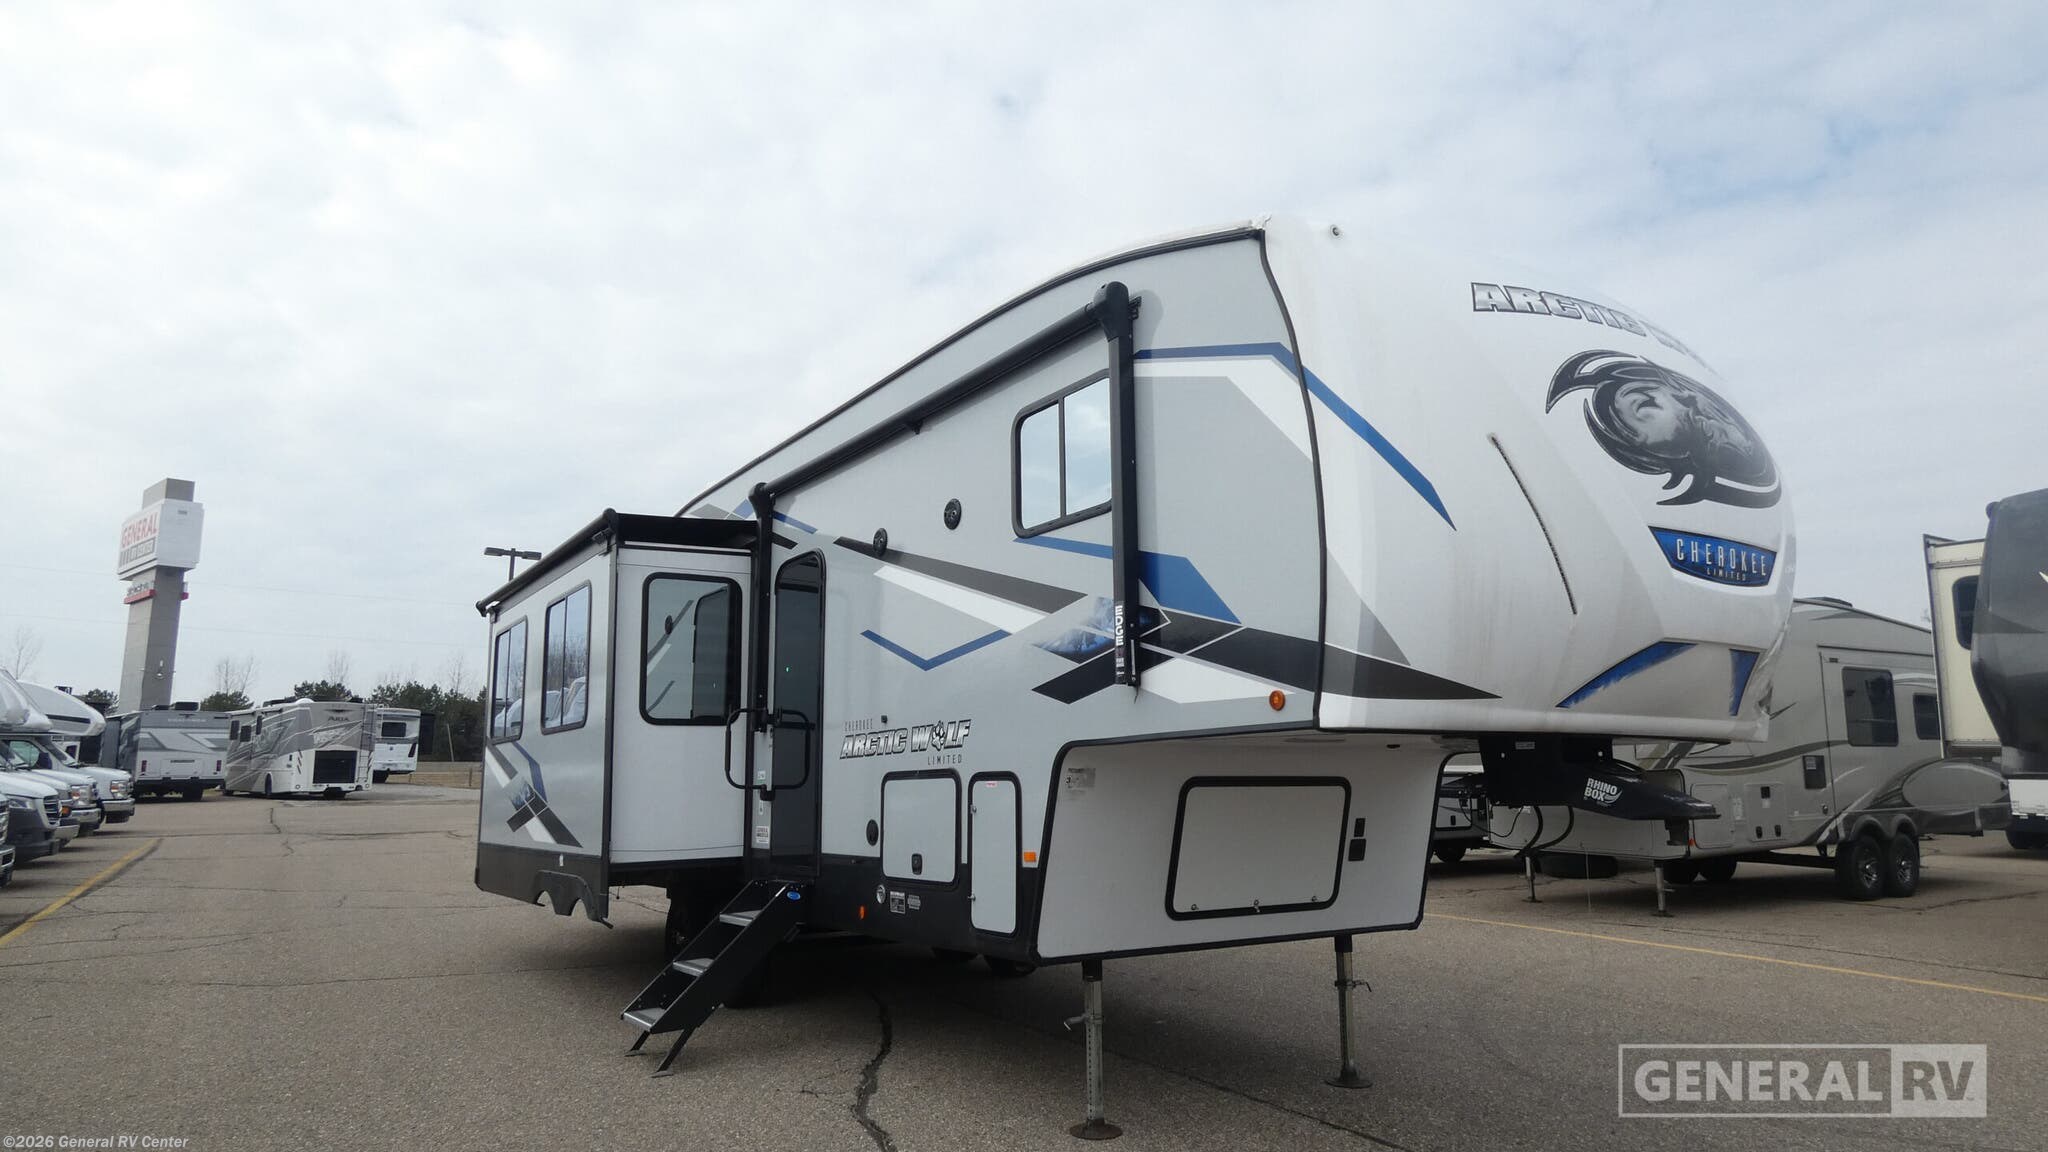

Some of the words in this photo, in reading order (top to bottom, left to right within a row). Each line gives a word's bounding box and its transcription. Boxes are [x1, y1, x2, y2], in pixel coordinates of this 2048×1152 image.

[1471, 282, 1647, 337] ARCTIC
[121, 511, 158, 548] GENERAL
[1676, 538, 1767, 577] CHEROKEE
[1707, 567, 1746, 582] LIMITED
[1115, 604, 1124, 647] EDGE
[839, 727, 908, 760] ARCTIC
[927, 754, 963, 766] LIMITED
[1584, 786, 1606, 802] BOX
[1587, 777, 1618, 795] RHINO
